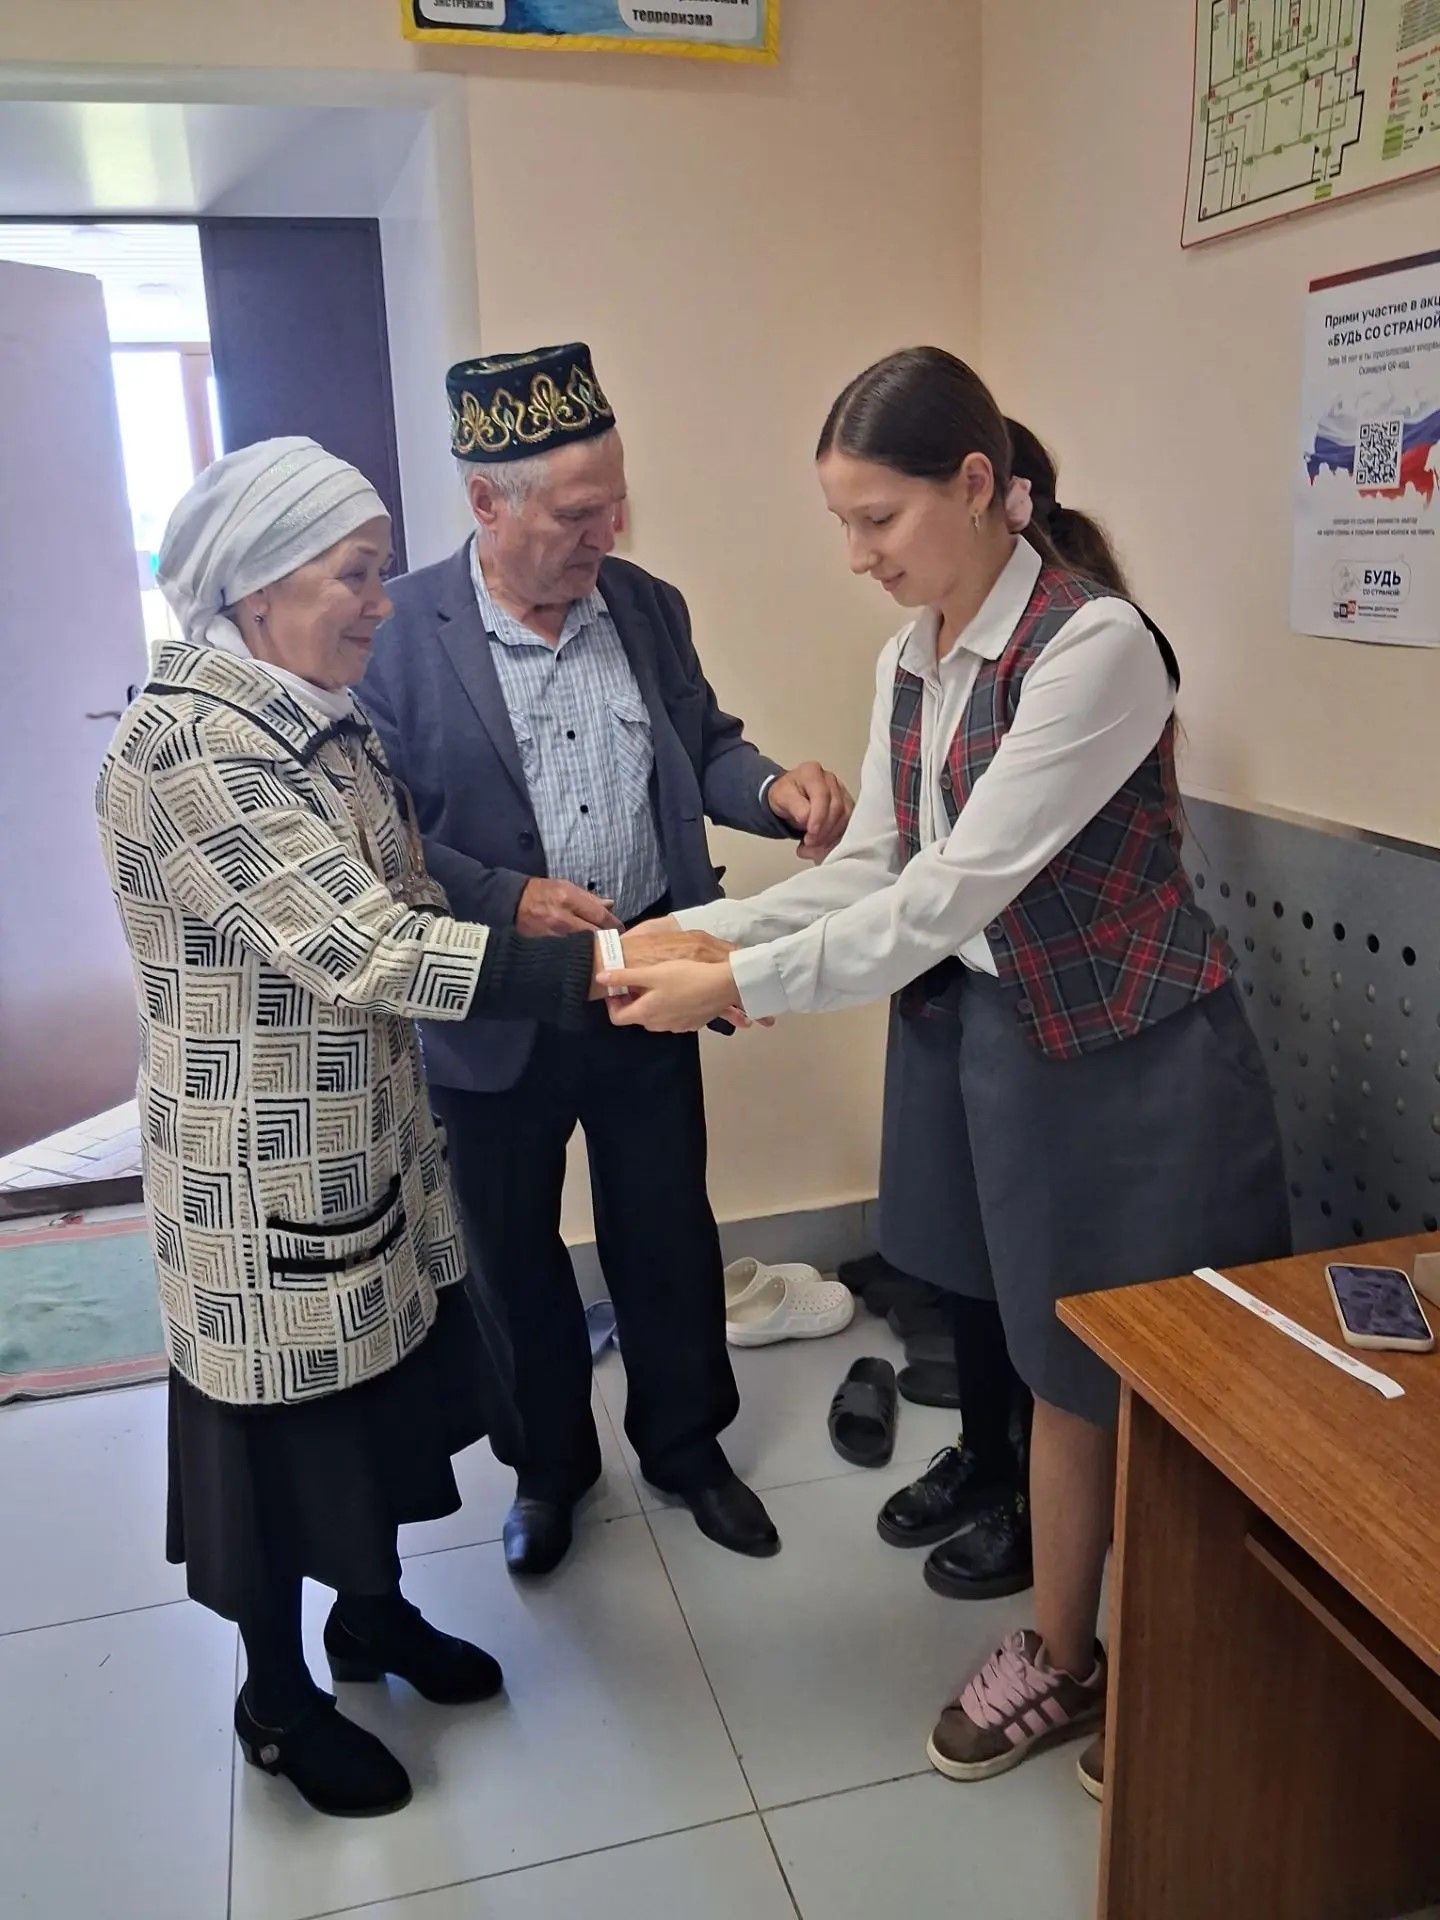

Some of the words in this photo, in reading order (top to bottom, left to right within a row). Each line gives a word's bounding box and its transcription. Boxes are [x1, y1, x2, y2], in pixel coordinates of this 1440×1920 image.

[632, 9, 713, 26] терроризма
[1325, 313, 1359, 329] Прими
[1361, 302, 1407, 323] участие
[1410, 300, 1417, 311] в
[1327, 329, 1362, 347] «БУДЬ
[1365, 325, 1381, 340] СО
[1364, 570, 1401, 587] БУДЬ
